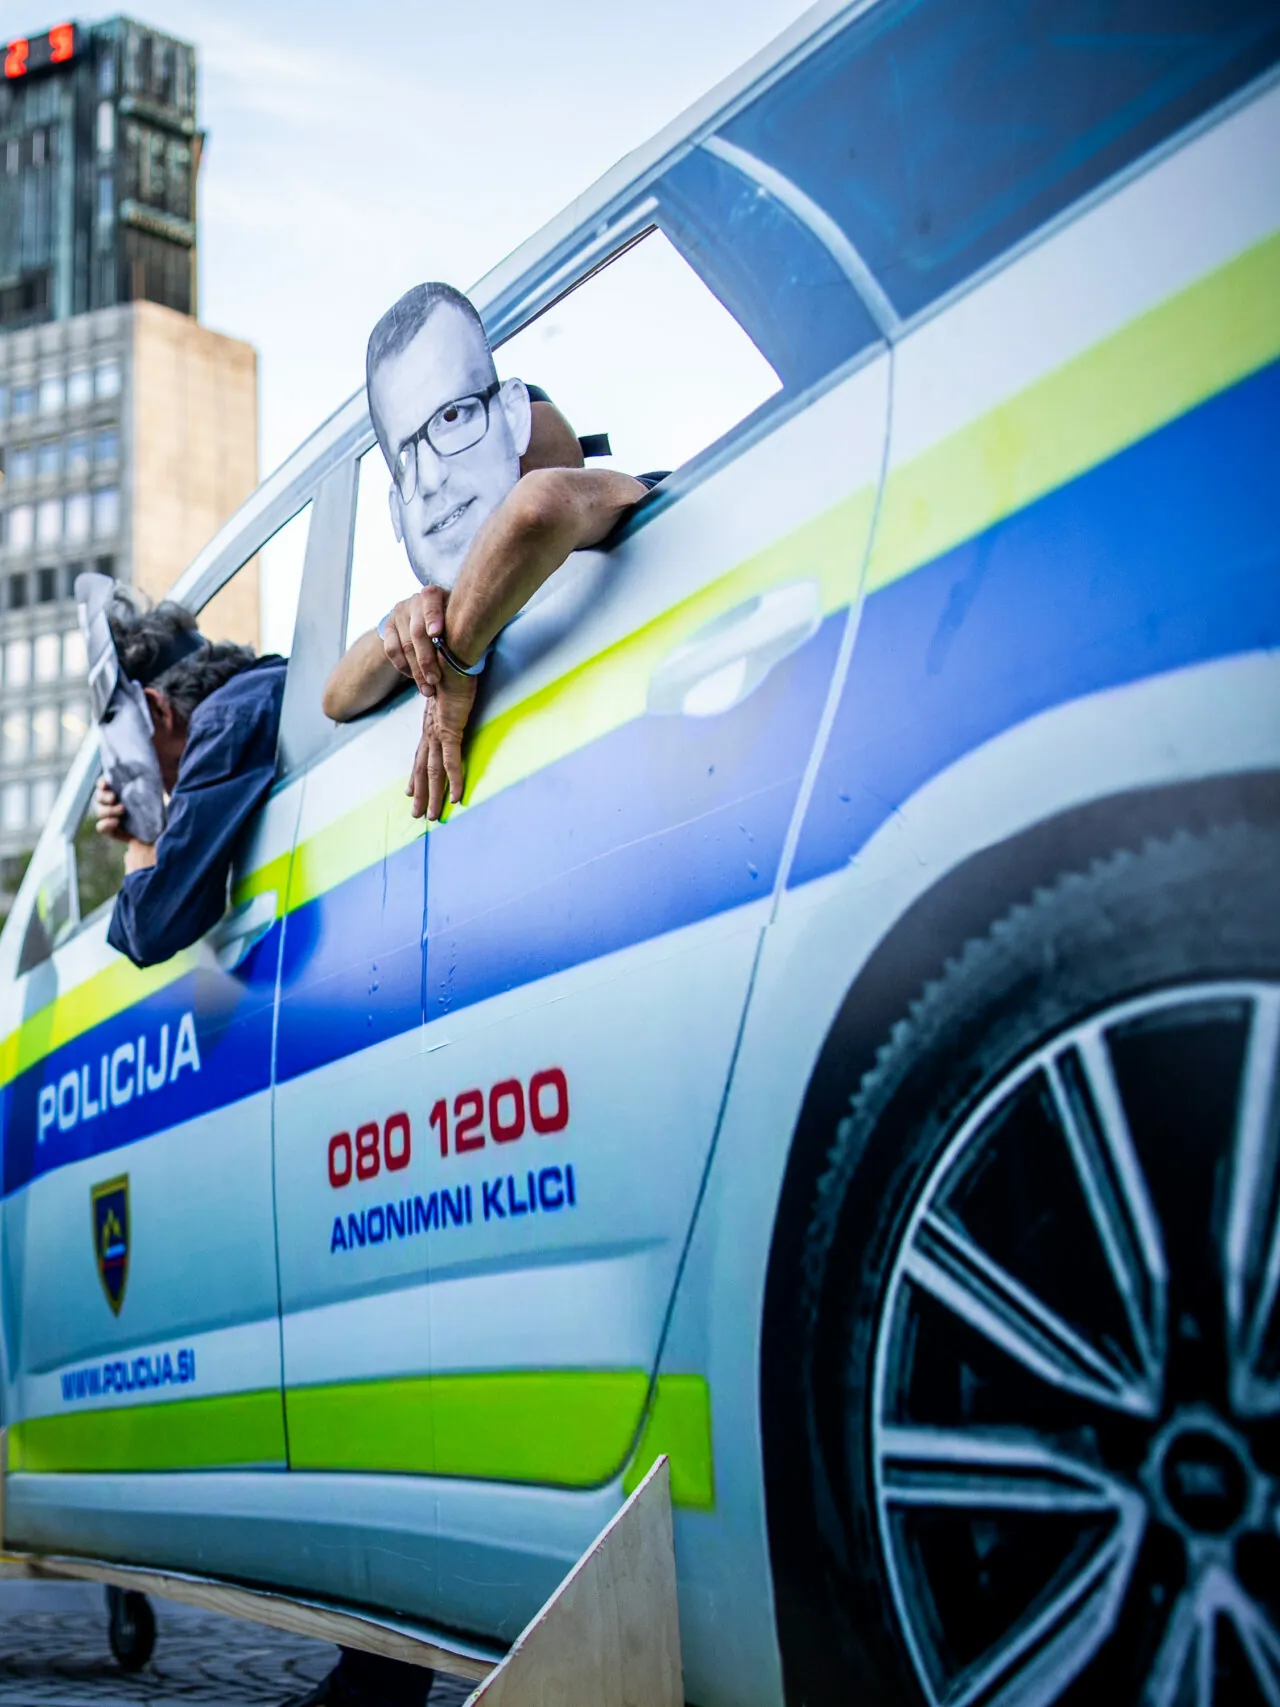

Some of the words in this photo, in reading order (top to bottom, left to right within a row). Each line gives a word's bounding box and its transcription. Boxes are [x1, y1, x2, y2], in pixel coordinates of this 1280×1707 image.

[37, 1012, 201, 1142] POLICIJA
[328, 1111, 410, 1189] 080
[429, 1067, 570, 1158] 1200
[330, 1184, 471, 1254] ANONIMNI
[482, 1164, 577, 1222] KLICI
[61, 1349, 195, 1401] WWW.POLICIJA.SI
